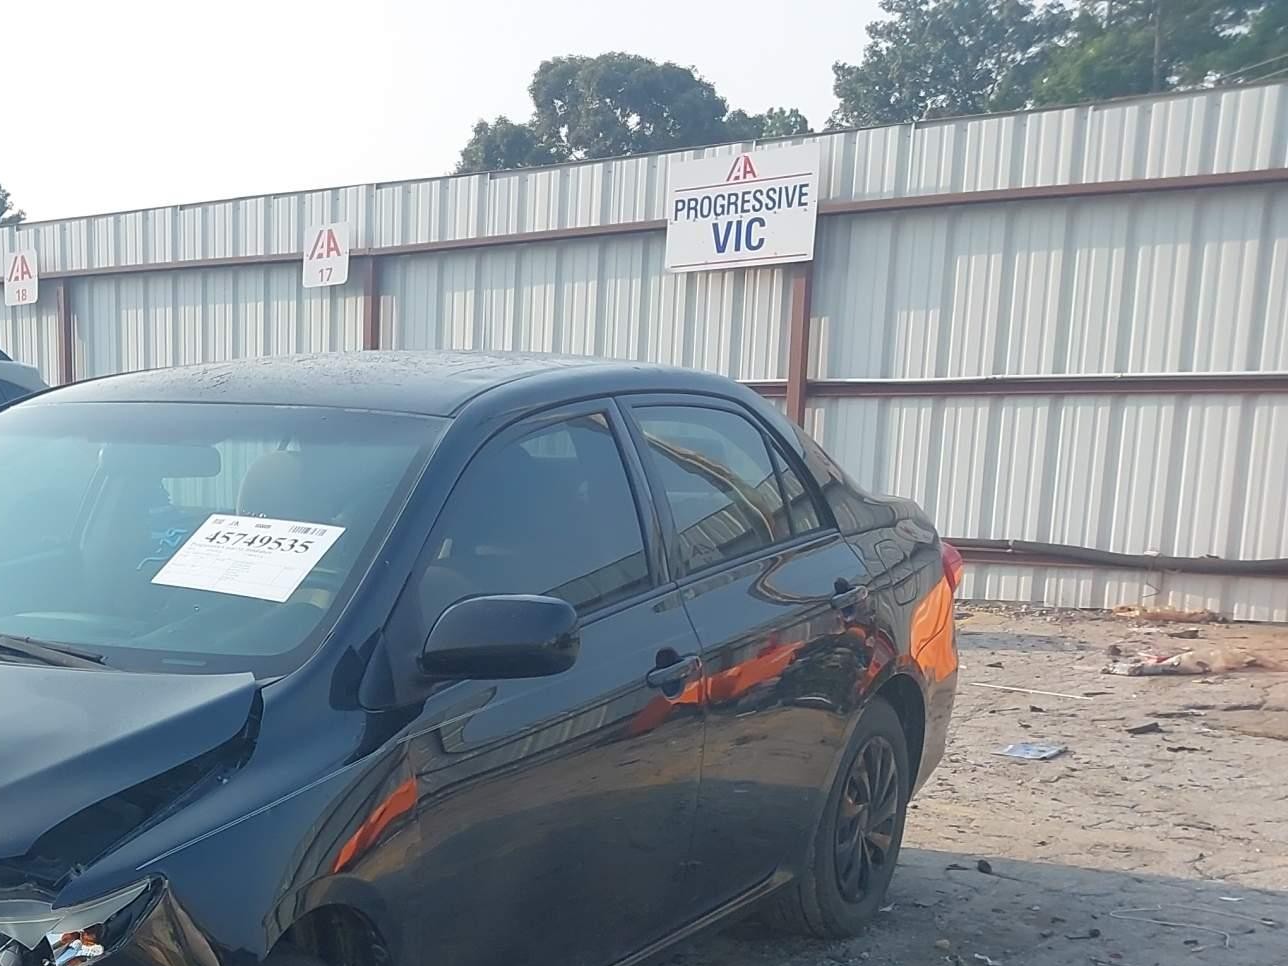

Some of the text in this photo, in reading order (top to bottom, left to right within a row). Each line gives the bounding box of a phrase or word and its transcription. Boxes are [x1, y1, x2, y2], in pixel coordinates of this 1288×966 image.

[674, 183, 810, 222] PROGRESSIVE
[712, 217, 766, 254] VIC
[319, 267, 333, 283] 17
[16, 288, 27, 302] 18
[205, 530, 315, 554] 45749535
